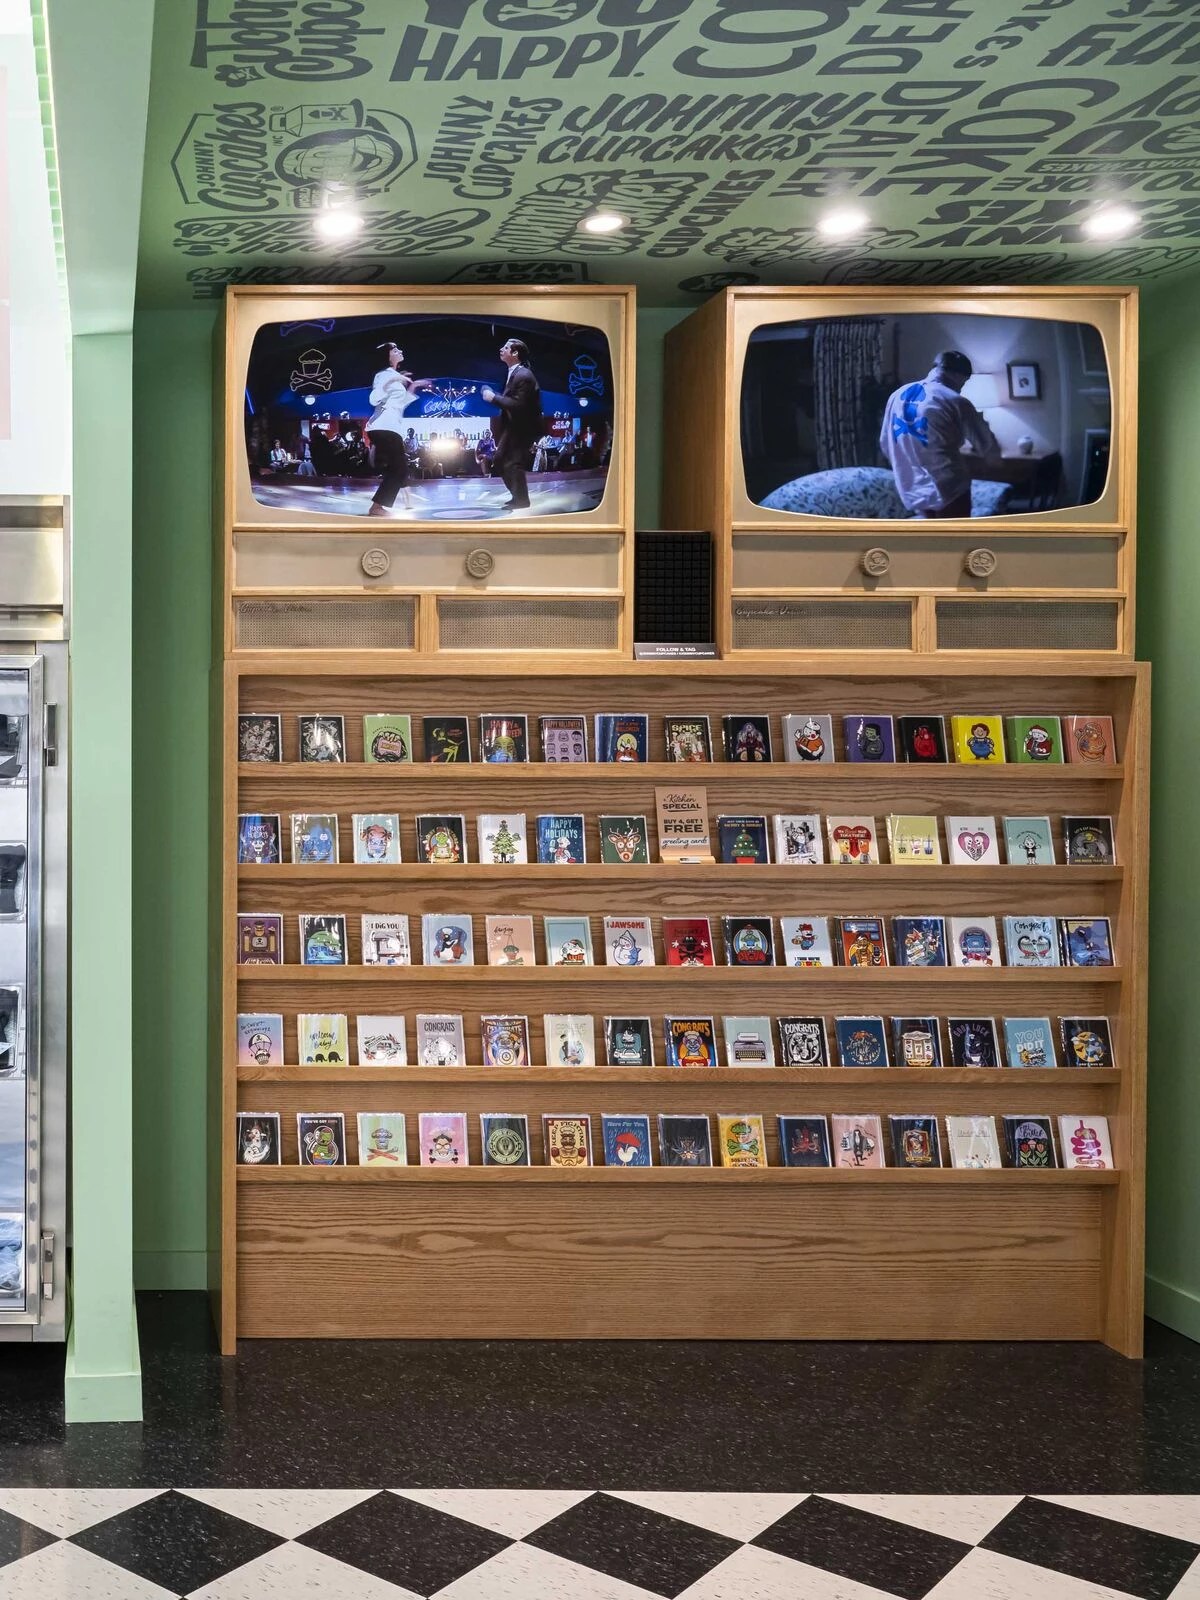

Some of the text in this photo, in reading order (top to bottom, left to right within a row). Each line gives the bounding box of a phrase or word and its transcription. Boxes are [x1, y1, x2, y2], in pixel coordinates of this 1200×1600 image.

[423, 94, 494, 184] JOHNNY
[453, 96, 564, 200] CUPCAKES
[193, 139, 216, 188] JOHNNY
[196, 101, 281, 212] Cupcakes
[646, 169, 776, 259] CUPCAKES
[175, 208, 491, 240] Cupakes
[672, 724, 704, 732] SPICE
[666, 793, 697, 804] Kitchen
[550, 818, 573, 829] HAPPY
[664, 825, 704, 834] FREE
[545, 828, 578, 840] HOLIDAYS
[661, 836, 708, 850] greeting cards
[424, 1022, 456, 1033] CONGRATS
[784, 1023, 820, 1036] CONGRATS
[1014, 1028, 1044, 1043] YOU
[1016, 1040, 1045, 1053] DID IT
[551, 1120, 586, 1147] KEEP FIGHTING
